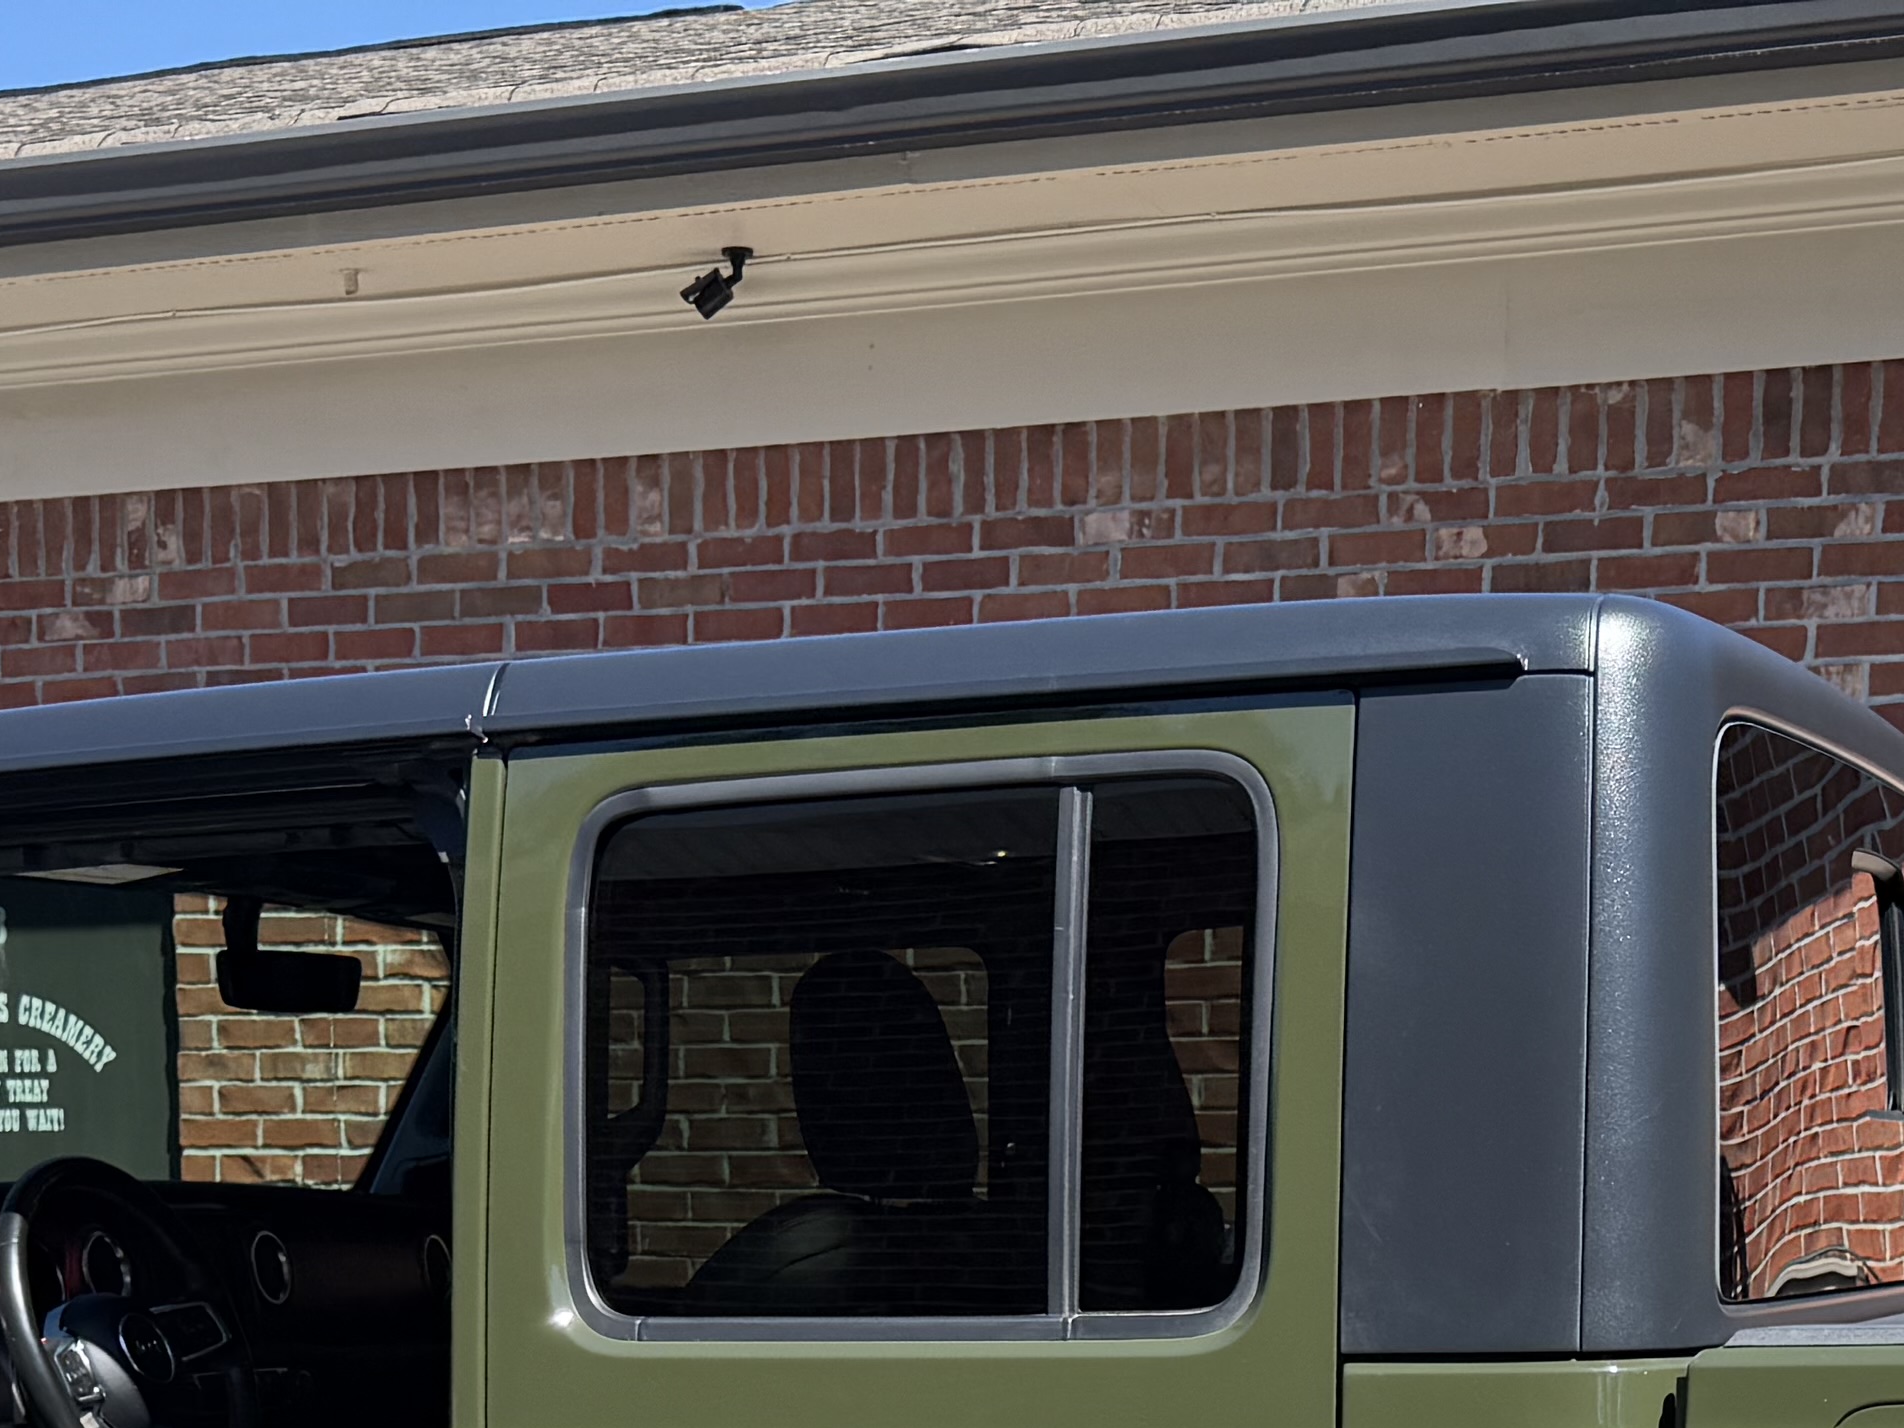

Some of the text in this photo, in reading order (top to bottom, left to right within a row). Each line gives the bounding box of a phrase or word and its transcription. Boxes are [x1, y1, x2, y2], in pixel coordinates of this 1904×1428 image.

[18, 994, 117, 1073] CREAMERY
[14, 1049, 42, 1073] FOR
[46, 1048, 57, 1073] A
[6, 1079, 50, 1103] TREAT
[25, 1108, 65, 1132] WAIT!
